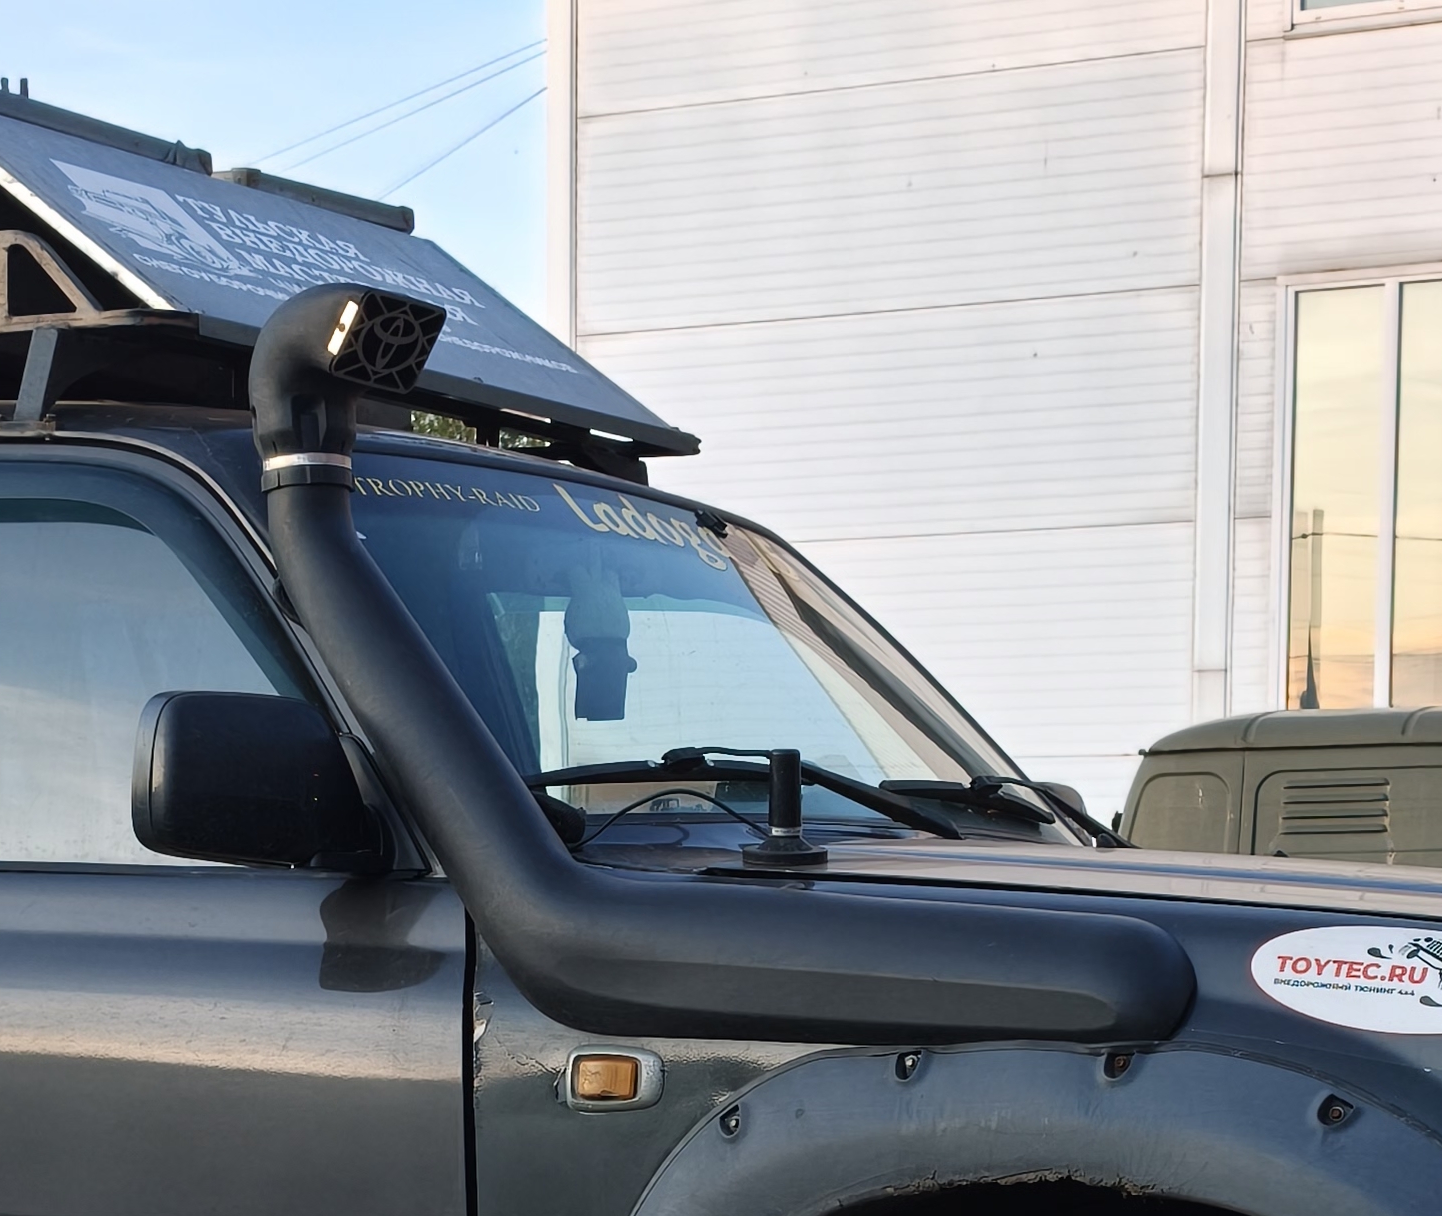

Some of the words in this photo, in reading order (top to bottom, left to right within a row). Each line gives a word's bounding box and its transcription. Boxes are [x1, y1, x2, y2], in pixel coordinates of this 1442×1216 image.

[175, 193, 371, 262] ТУЛЬСКАЯ
[205, 221, 486, 308] ВНЕДОРОЖНАЯ
[354, 476, 541, 512] TROPHY-RAID
[1277, 955, 1429, 985] TOYTEC.RU
